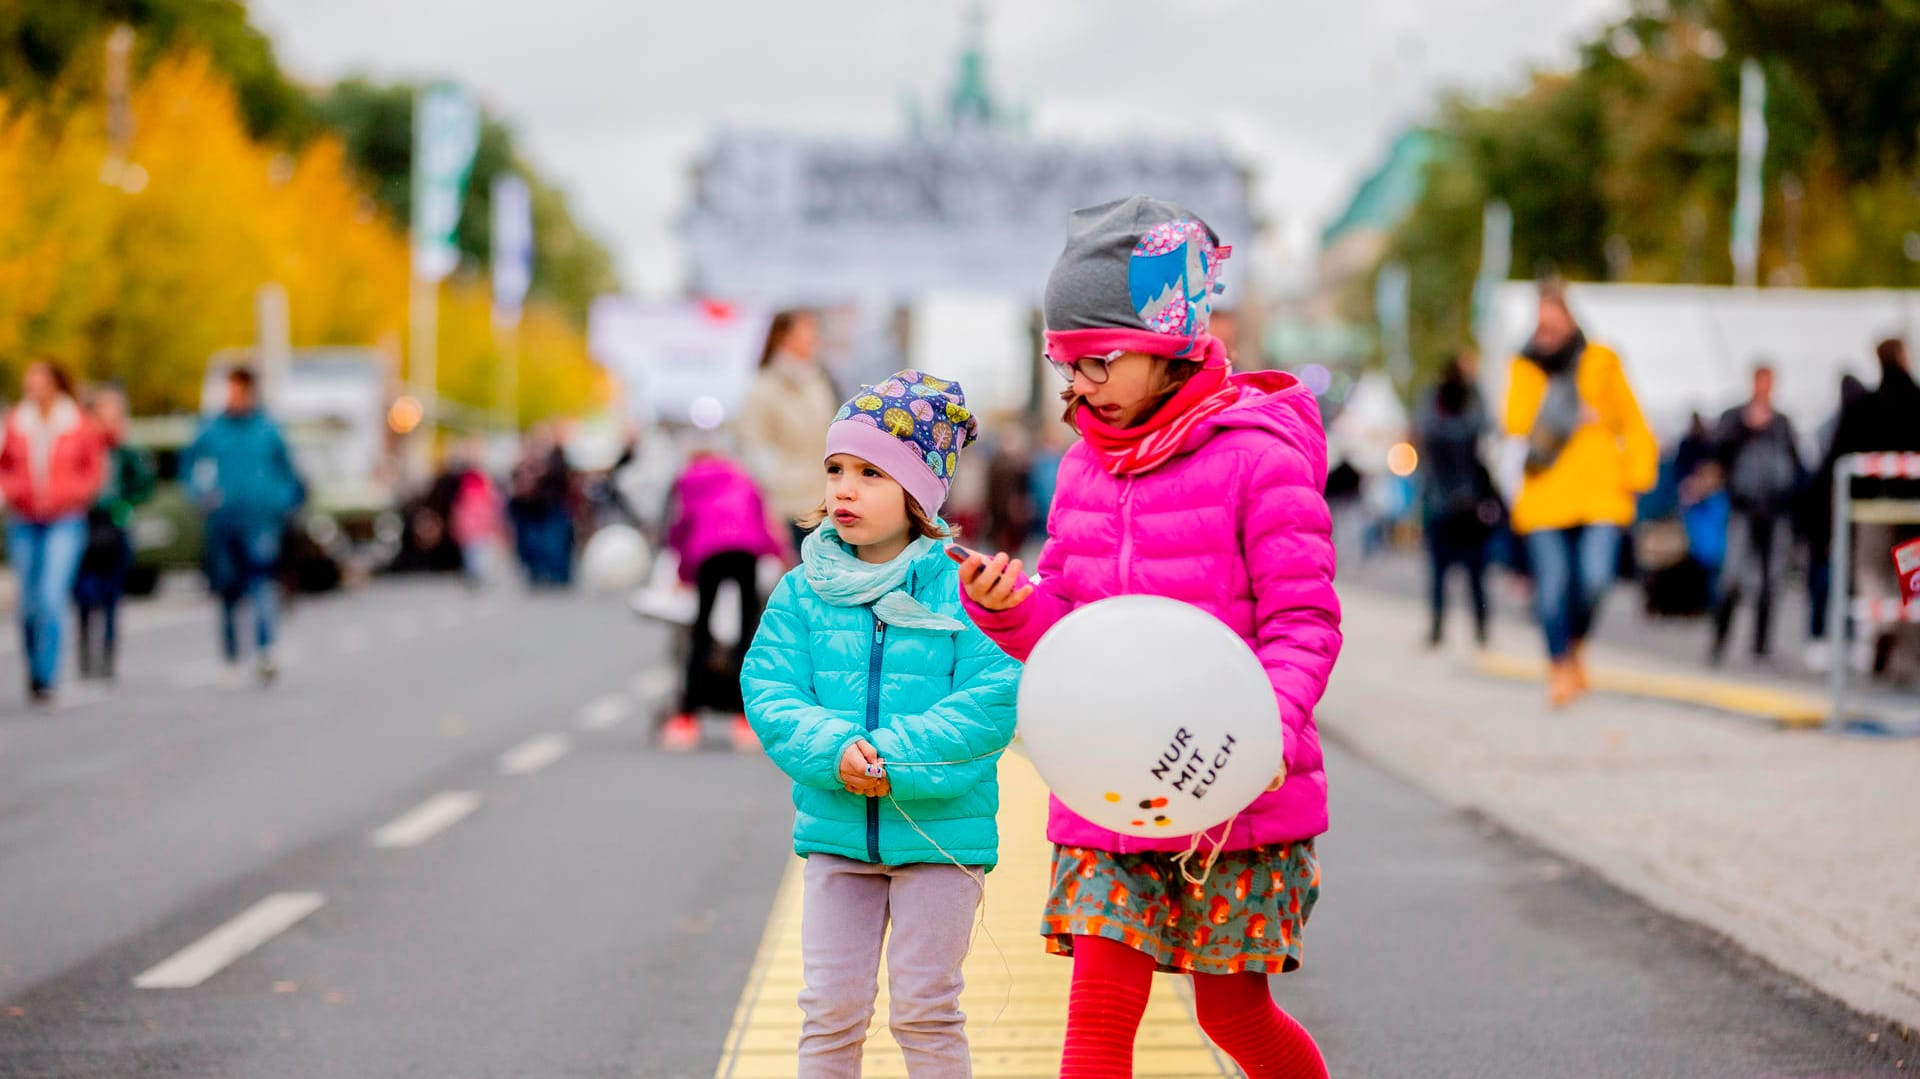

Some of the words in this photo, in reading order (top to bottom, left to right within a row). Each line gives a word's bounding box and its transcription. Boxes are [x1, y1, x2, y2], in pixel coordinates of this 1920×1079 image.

[1151, 727, 1192, 781] NUR
[1172, 749, 1205, 792] MIT
[1191, 734, 1237, 799] EUCH
